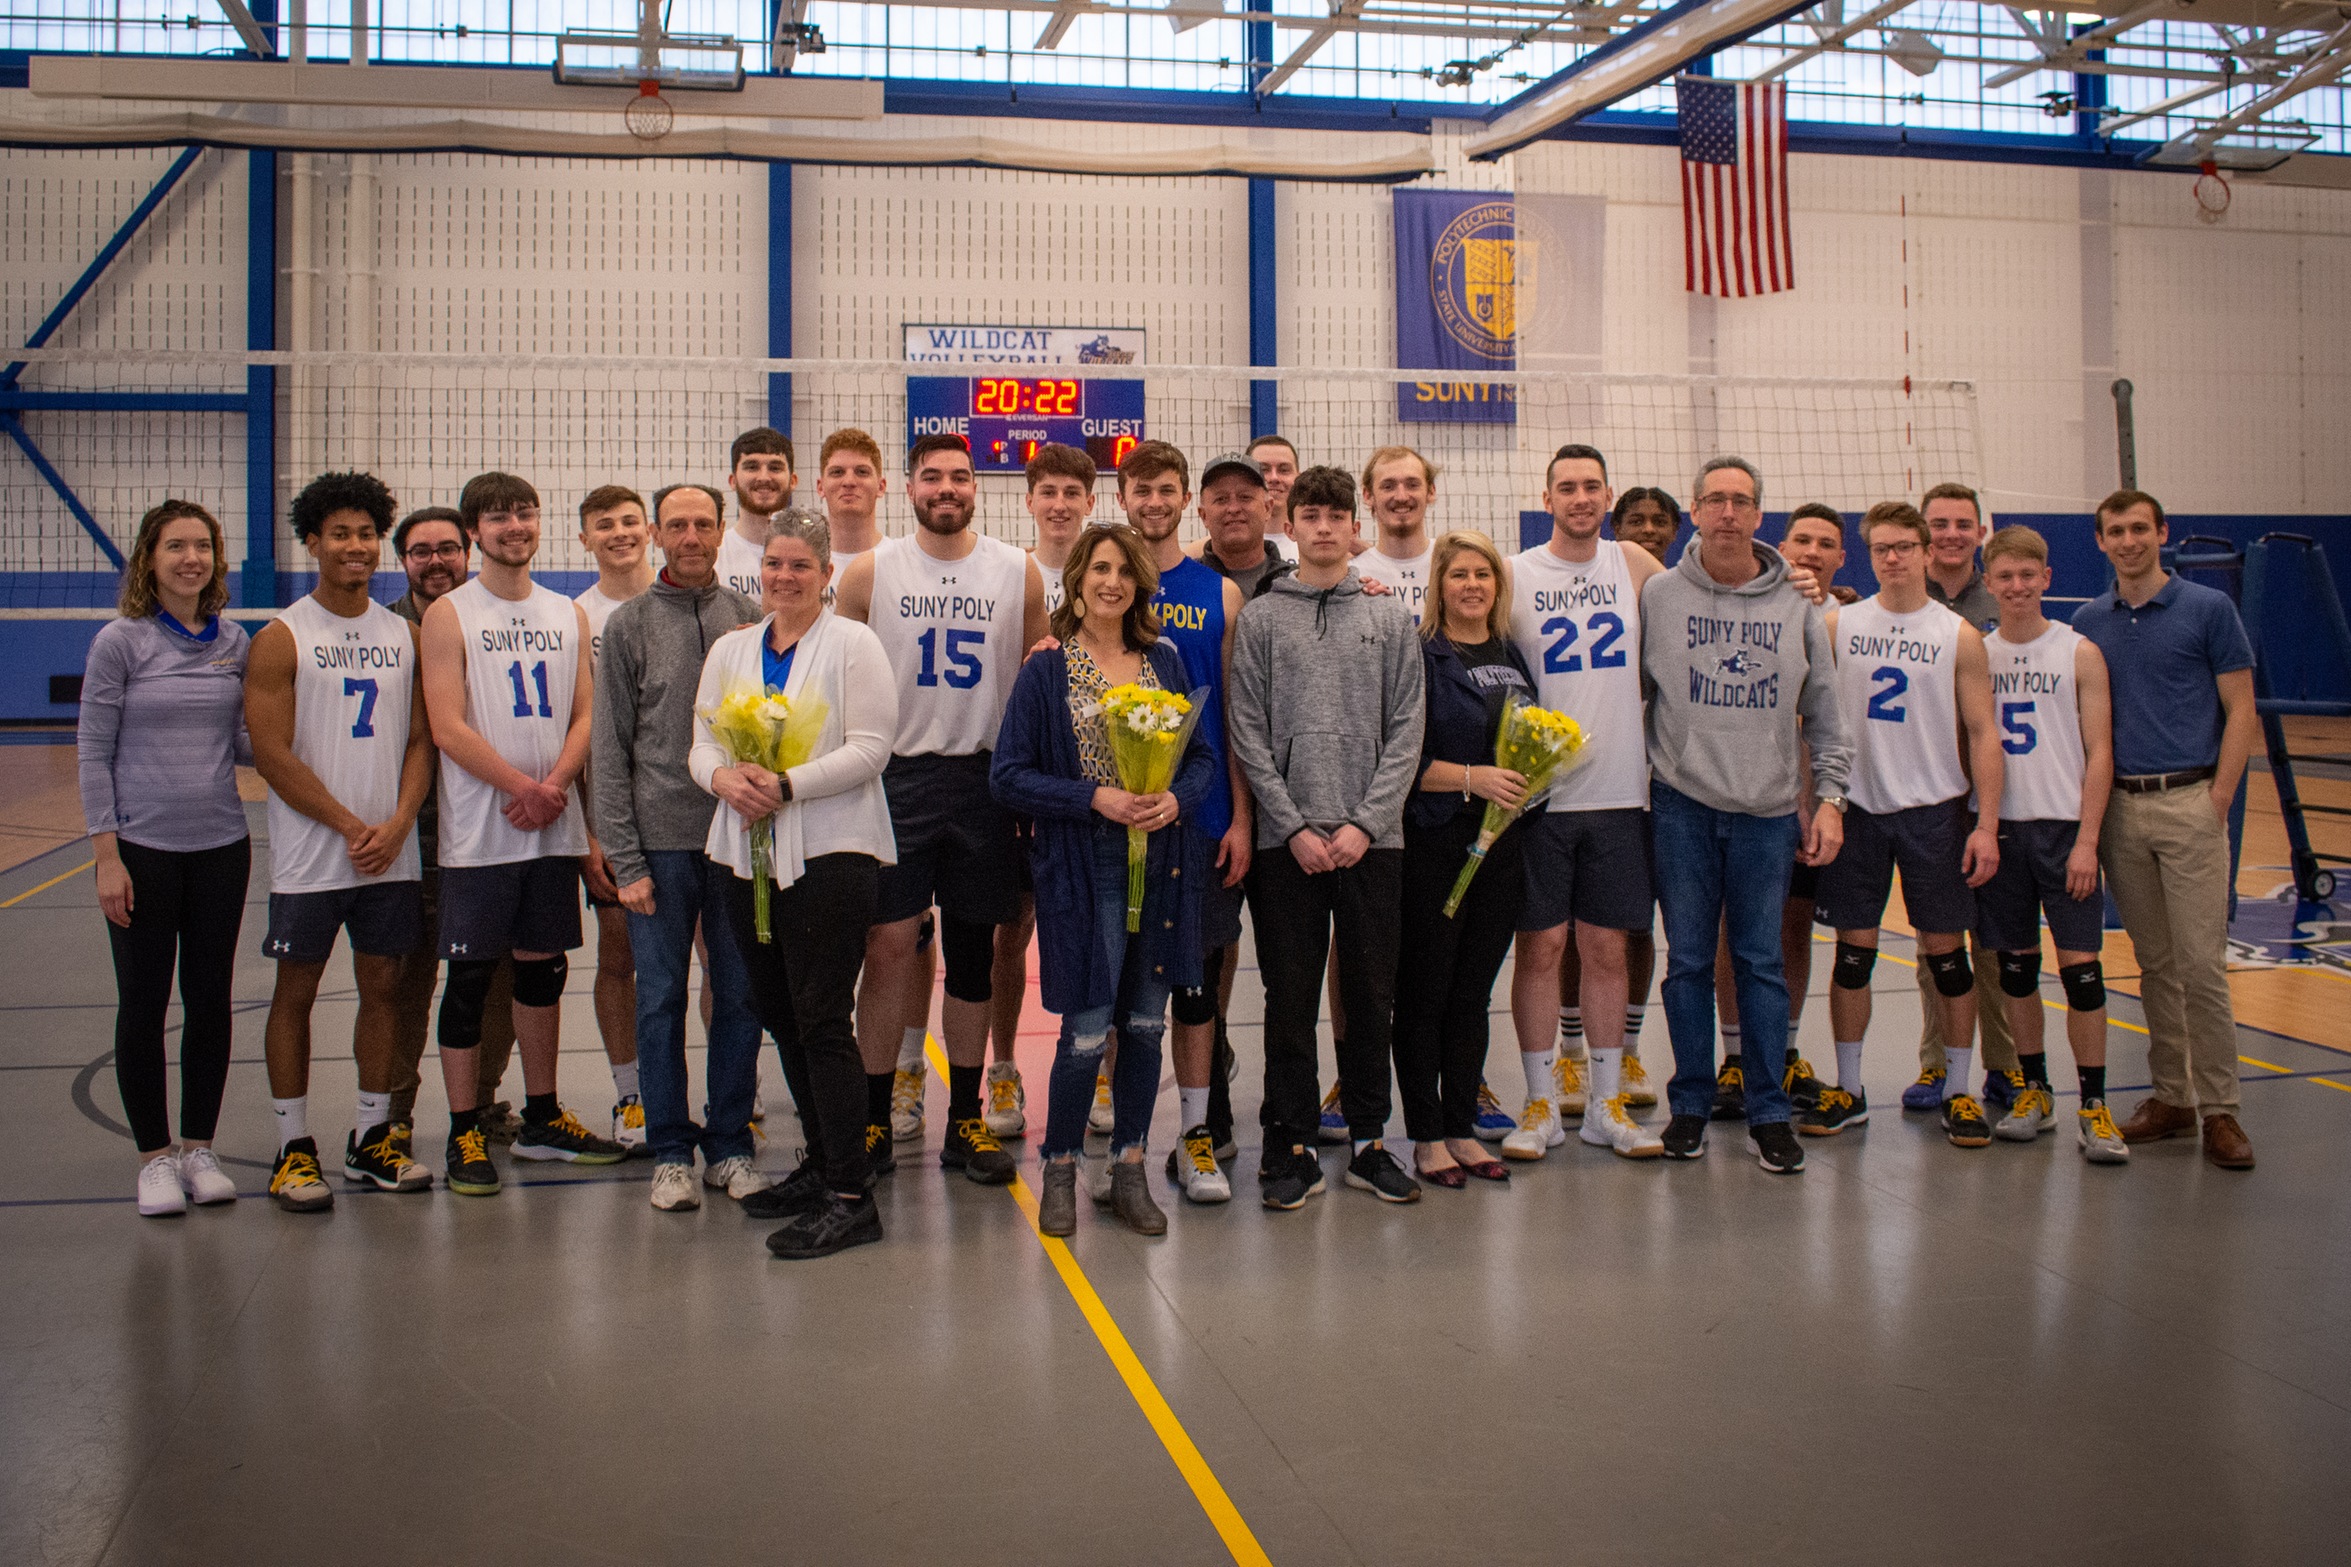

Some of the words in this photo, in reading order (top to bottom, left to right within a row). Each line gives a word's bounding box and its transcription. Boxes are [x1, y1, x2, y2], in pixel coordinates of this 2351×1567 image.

[1437, 207, 1513, 265] POLYTECHNIC
[928, 329, 1052, 350] WILDCAT
[976, 379, 1077, 413] 20:22
[1416, 382, 1491, 402] SUNY
[914, 416, 970, 436] HOME
[1008, 429, 1048, 441] PERIOD
[1081, 418, 1143, 437] GUEST
[729, 575, 762, 595] SUN
[1535, 590, 1576, 612] SUNY
[1580, 583, 1618, 608] POLY
[900, 595, 948, 619] SUNY
[952, 596, 996, 622] POLY
[1162, 603, 1208, 632] POLY
[481, 629, 522, 652] SUNY
[525, 630, 563, 652] POLY
[1540, 611, 1627, 675] 22
[1688, 615, 1735, 650] SUNY
[1741, 622, 1782, 655] POLY
[314, 646, 355, 669] SUNY
[359, 646, 401, 669] POLY
[916, 627, 986, 690] 15
[1849, 635, 1896, 660] SUNY
[1898, 639, 1942, 665] POLY
[508, 660, 553, 719] 11
[1689, 665, 1779, 709] WILDCATS
[1867, 665, 1909, 723] 2
[1988, 672, 2020, 694] UNY
[2024, 672, 2062, 695] POLY
[343, 676, 379, 738] 7
[2001, 700, 2038, 755] 5
